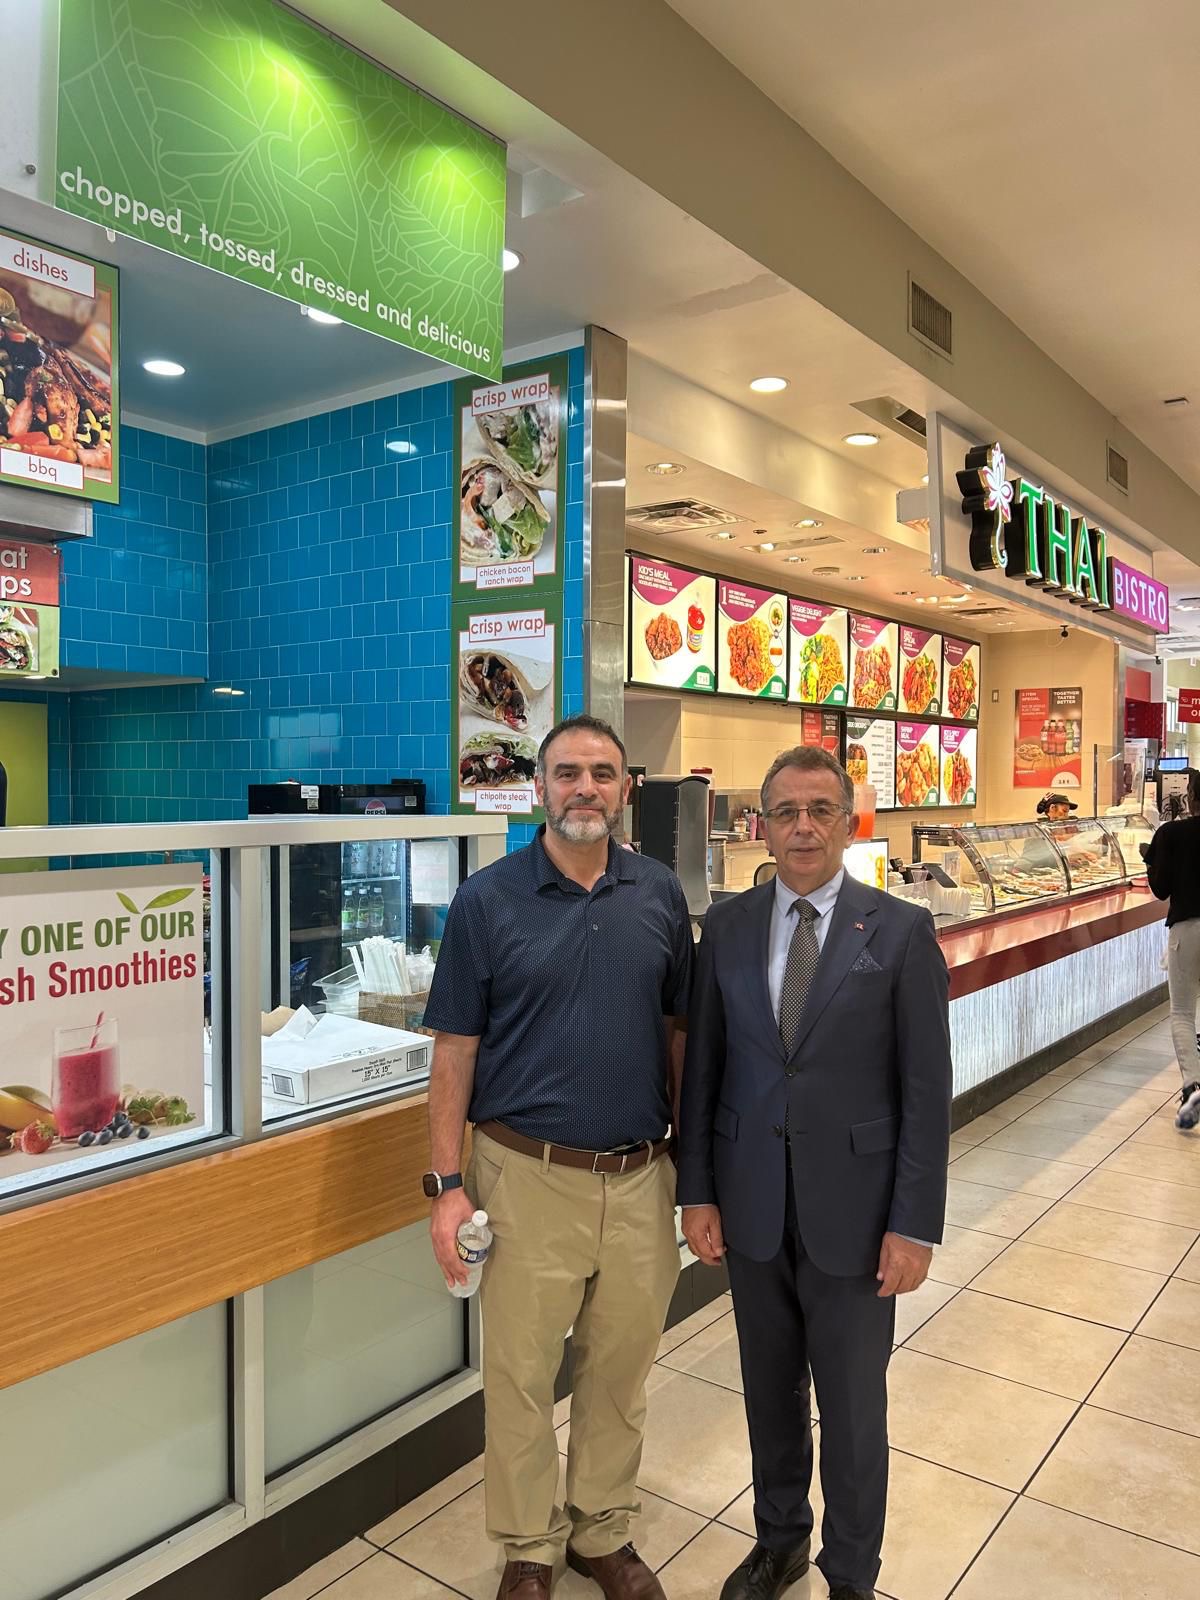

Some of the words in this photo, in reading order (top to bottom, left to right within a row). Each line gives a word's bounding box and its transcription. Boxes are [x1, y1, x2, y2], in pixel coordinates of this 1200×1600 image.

[13, 247, 69, 282] dishes
[59, 165, 190, 243] chopped,
[199, 227, 283, 282] tossed,
[291, 261, 370, 313] dressed
[376, 302, 412, 330] and
[417, 314, 492, 363] delicious
[473, 390, 506, 408] crisp
[511, 382, 548, 399] wrap
[28, 456, 58, 482] bbq
[1016, 477, 1111, 609] THAI
[479, 567, 507, 577] chicken
[508, 565, 531, 575] bacon
[485, 575, 505, 586] ranch
[506, 575, 524, 585] wrap
[721, 586, 728, 605] 1
[1113, 567, 1167, 625] BISTRO
[471, 619, 502, 636] crisp
[507, 616, 544, 633] wrap
[494, 801, 512, 811] wrap
[508, 791, 528, 801] steak
[21, 920, 84, 956] ONE
[94, 916, 131, 948] OF
[140, 910, 195, 943] OUR
[48, 948, 197, 998] Smoothies
